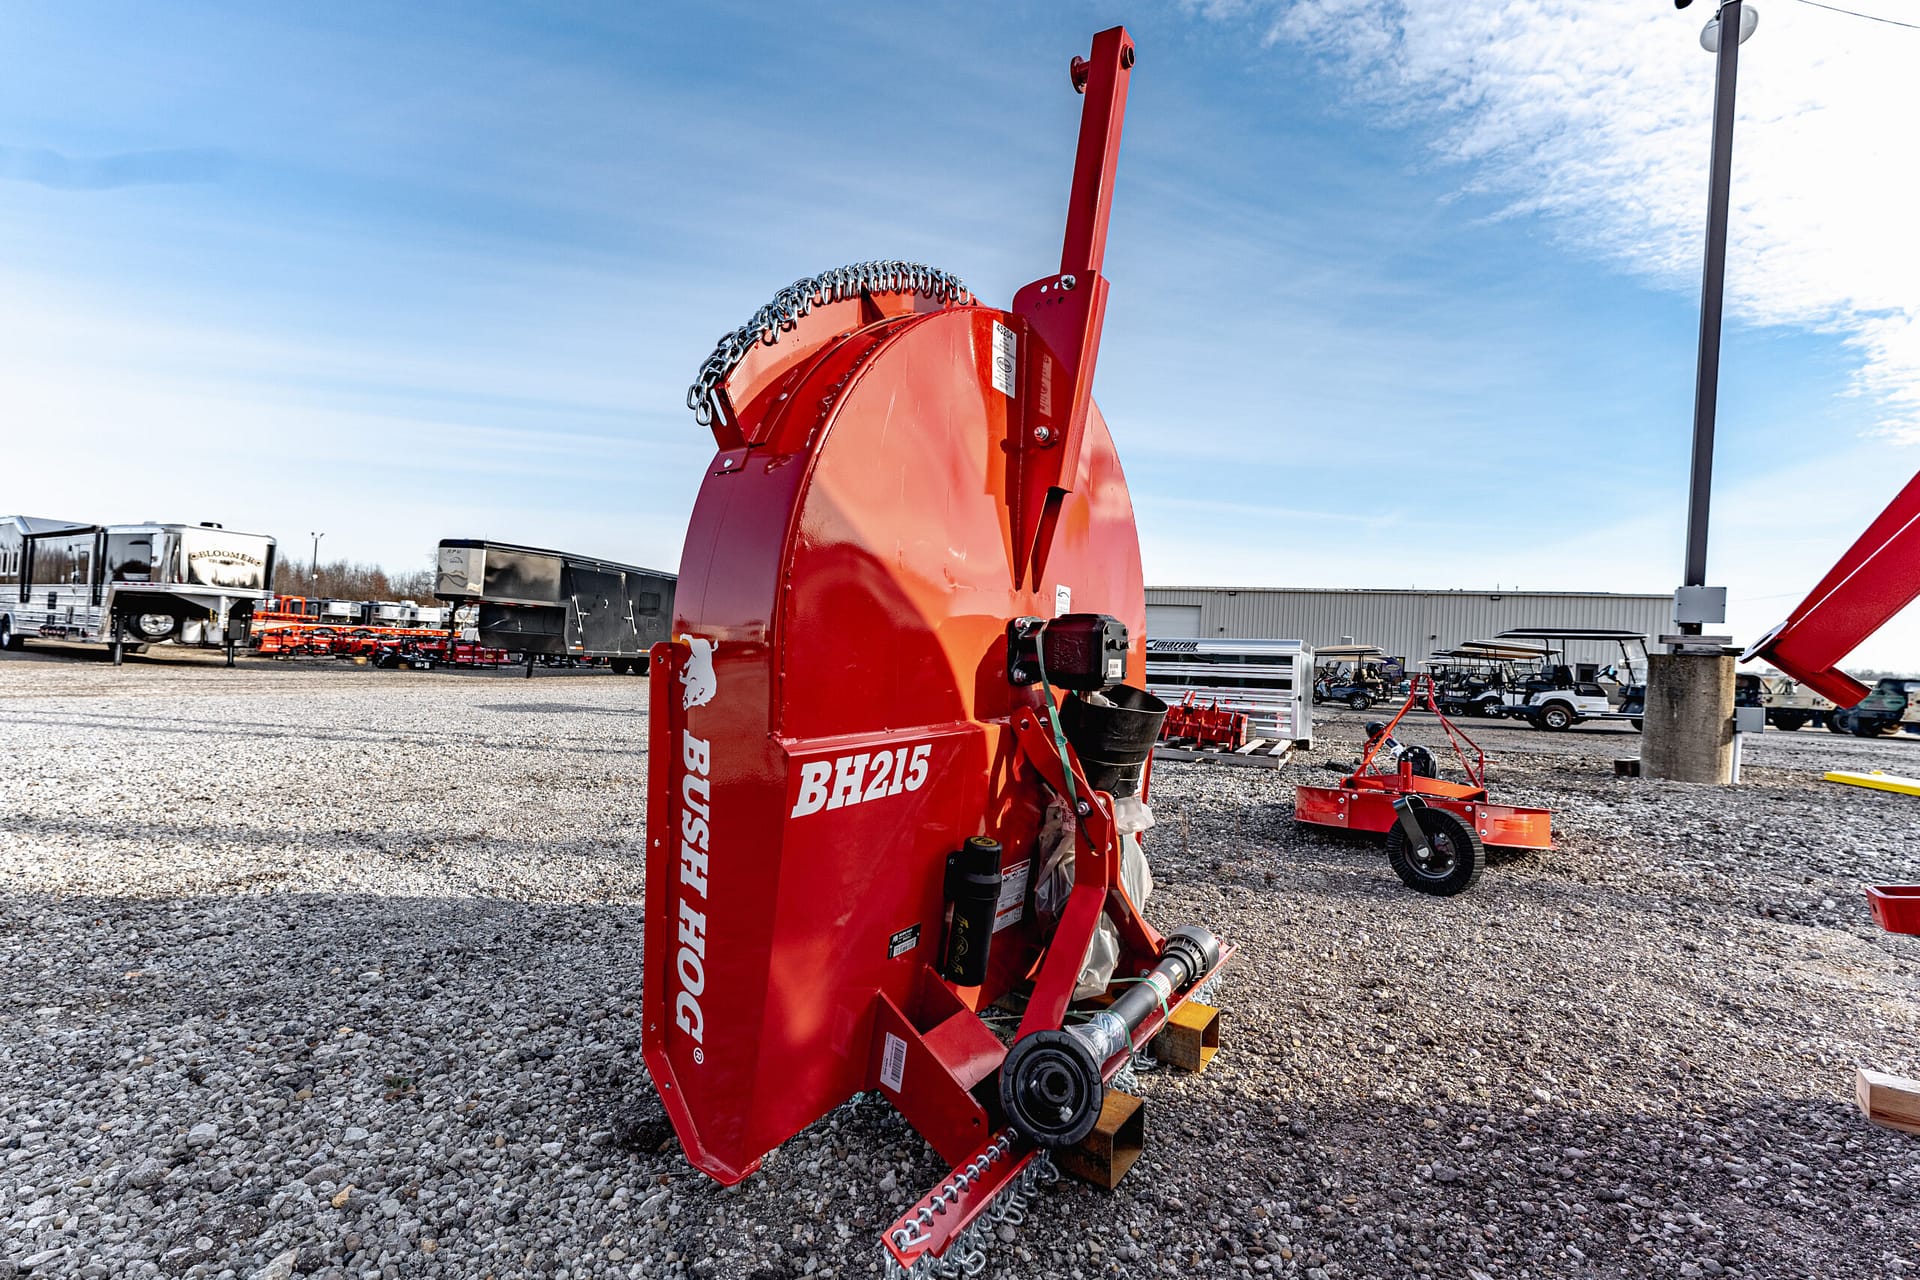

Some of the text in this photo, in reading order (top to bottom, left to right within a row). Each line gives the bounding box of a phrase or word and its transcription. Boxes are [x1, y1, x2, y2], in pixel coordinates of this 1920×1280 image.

[198, 550, 255, 564] BLOOMER
[1146, 639, 1199, 650] Cimarron
[679, 729, 711, 900] BUSH
[790, 744, 932, 819] BH215
[676, 896, 707, 1044] HOG
